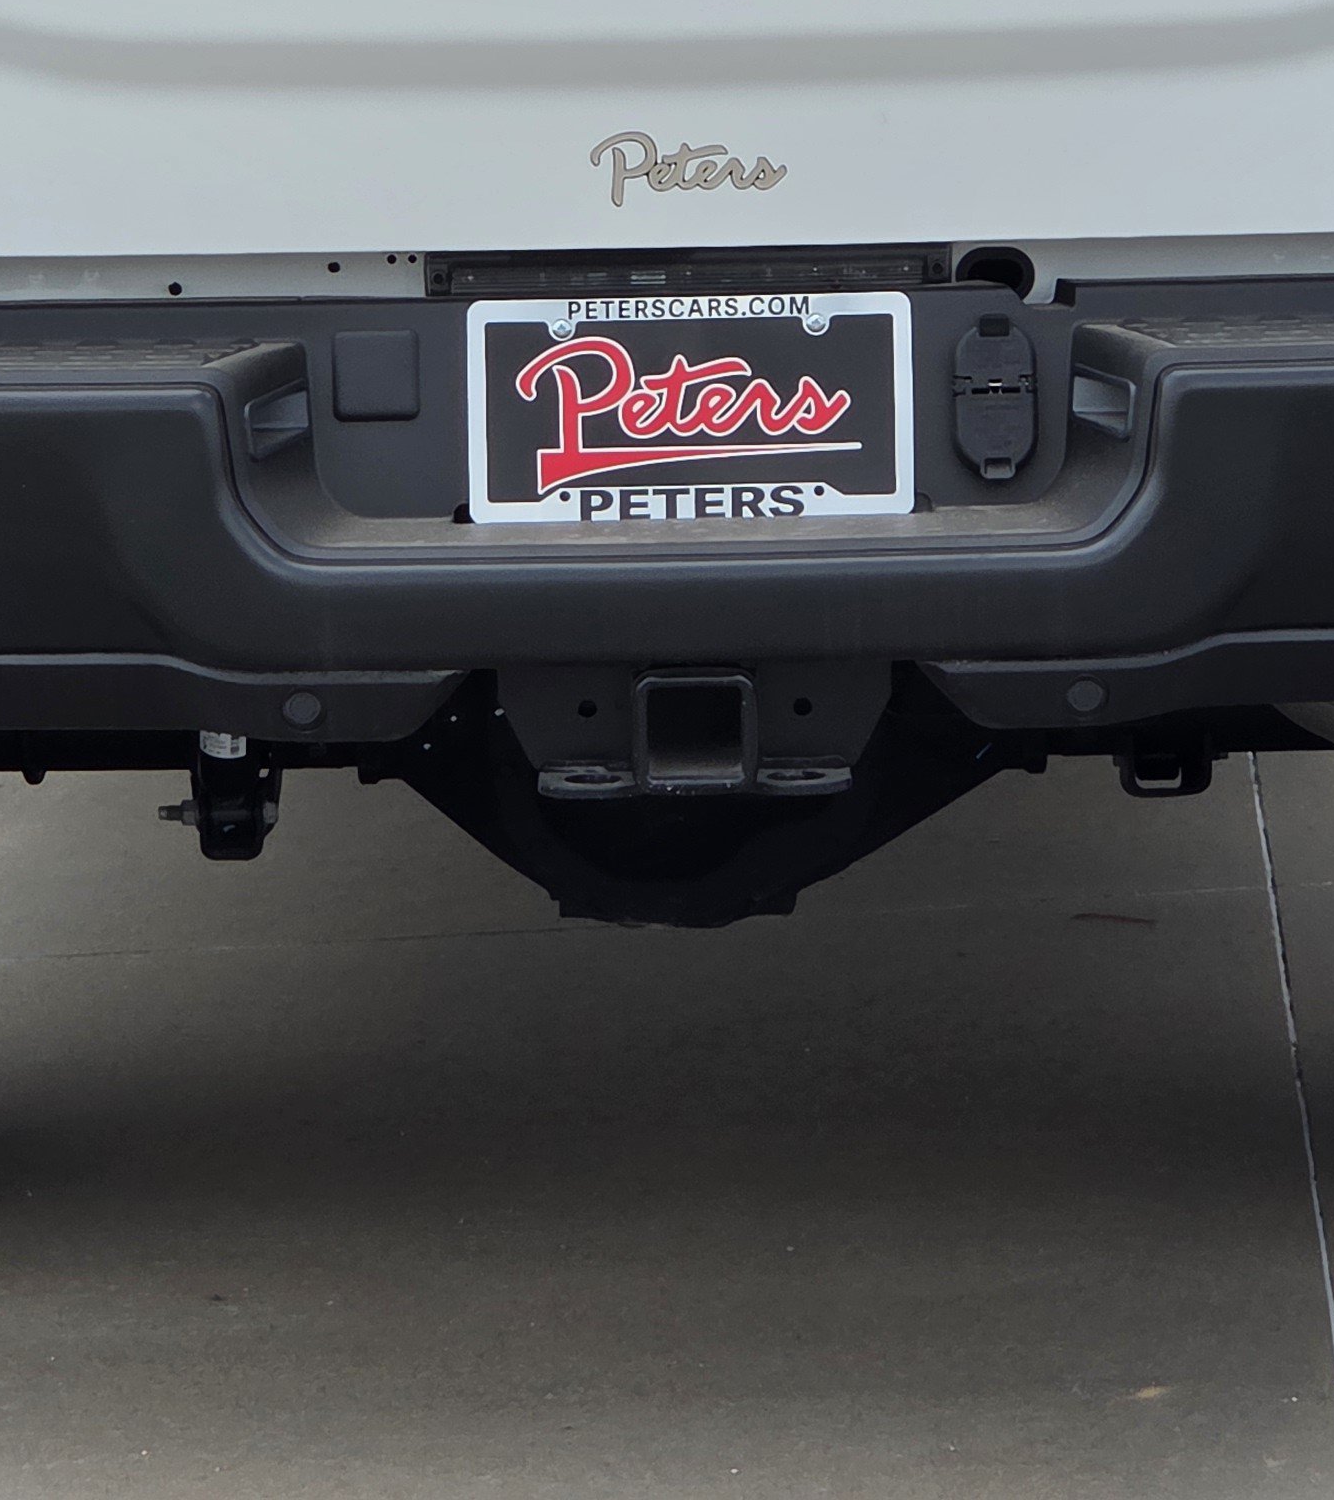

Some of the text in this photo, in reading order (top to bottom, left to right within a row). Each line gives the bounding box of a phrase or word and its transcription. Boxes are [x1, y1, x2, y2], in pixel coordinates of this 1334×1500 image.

[589, 131, 788, 208] Peters
[567, 295, 812, 321] PETERSCARS.COM
[515, 336, 863, 495] Peters
[579, 484, 806, 522] PETERS
